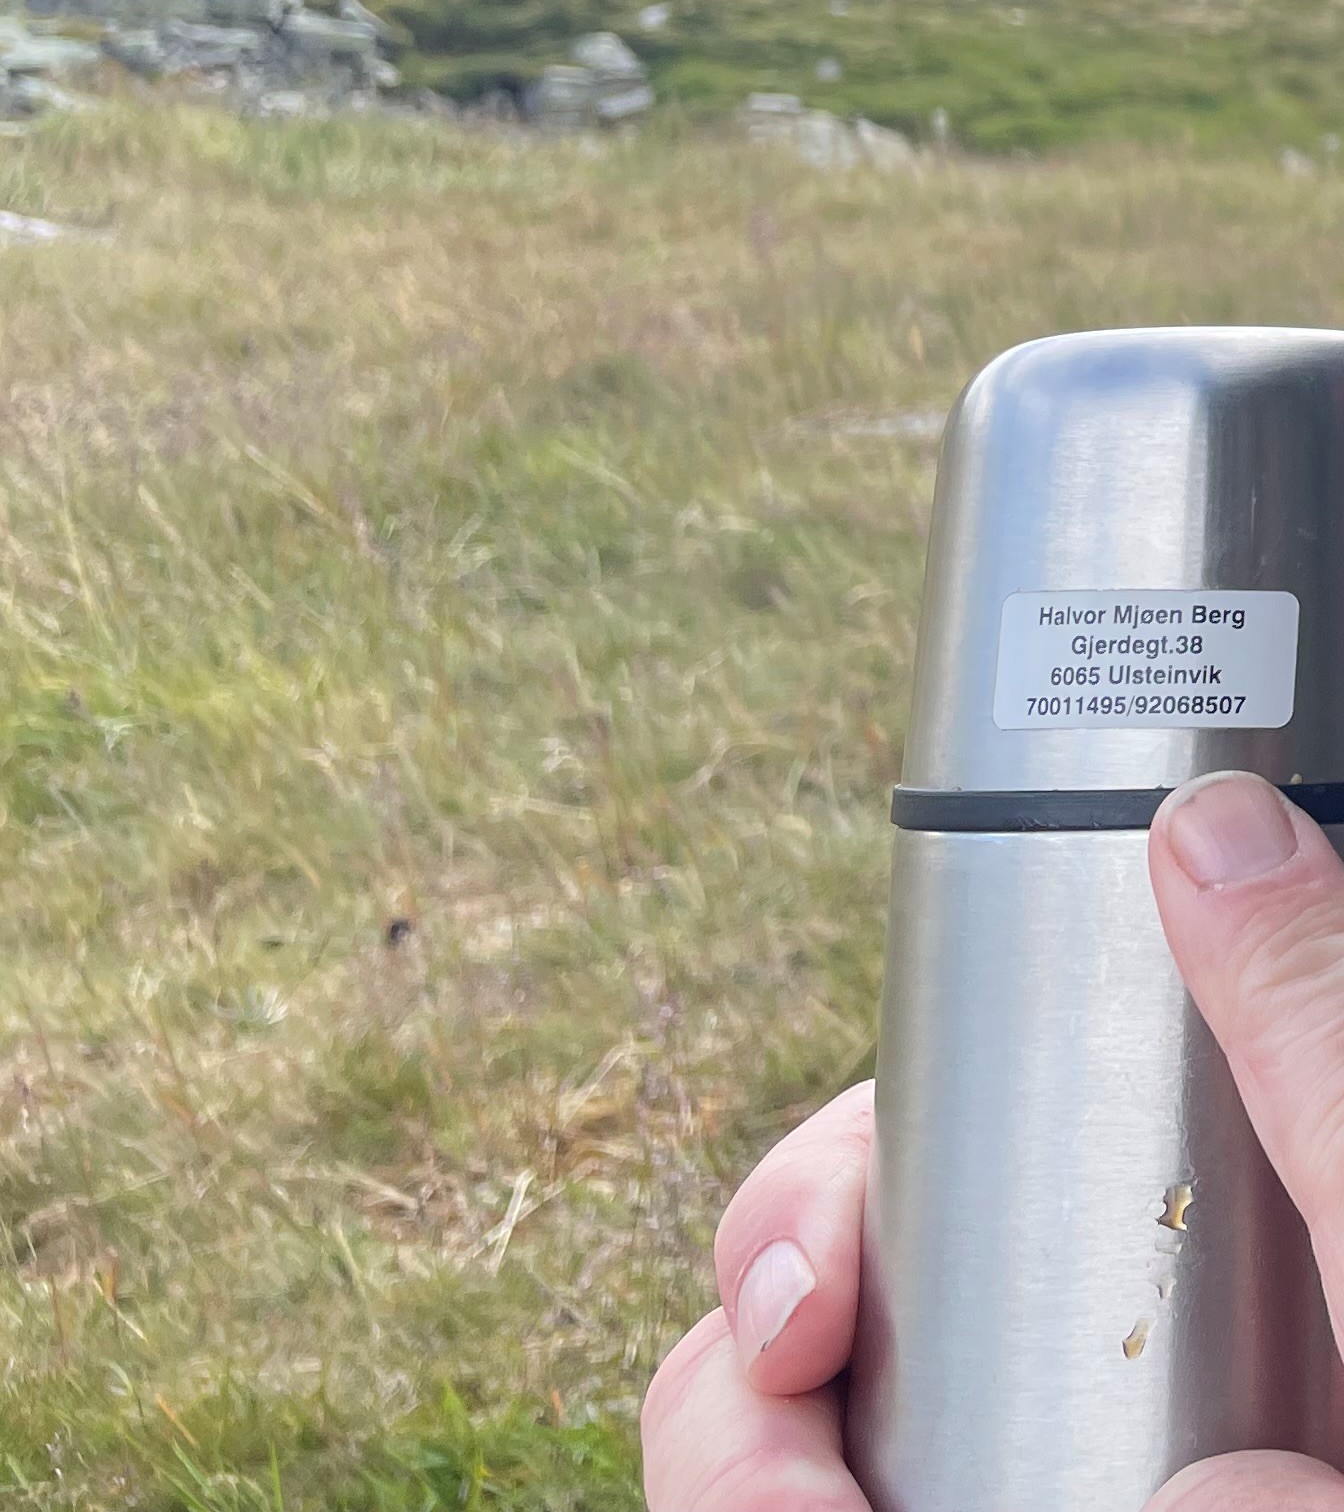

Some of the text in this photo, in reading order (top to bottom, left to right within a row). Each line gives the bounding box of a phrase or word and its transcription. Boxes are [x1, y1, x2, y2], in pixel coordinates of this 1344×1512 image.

[1038, 604, 1246, 630] Halvor Mjøen Berg
[1071, 634, 1203, 660] Gjerdegt.38
[1050, 664, 1222, 686] 6065 Ulsteinvik
[1026, 695, 1247, 717] 70011495/92068507
